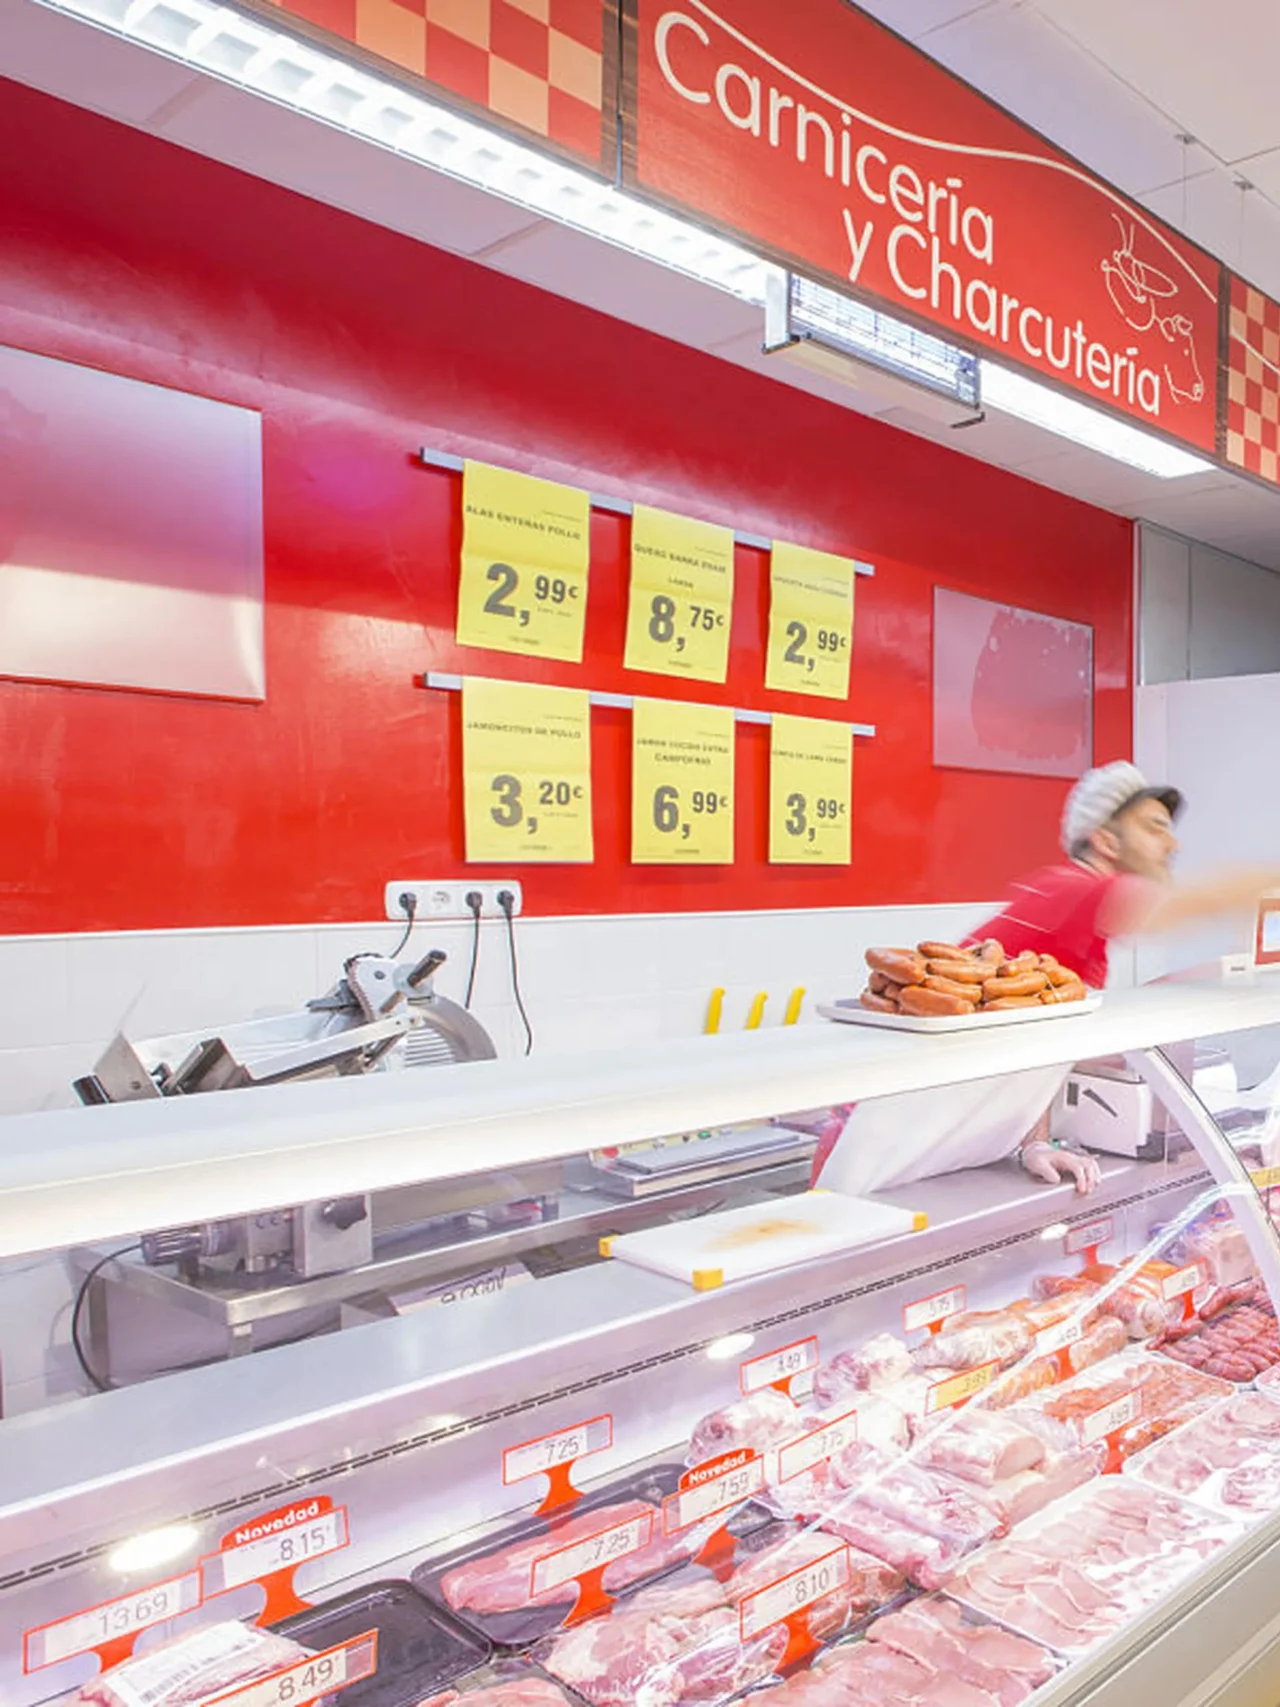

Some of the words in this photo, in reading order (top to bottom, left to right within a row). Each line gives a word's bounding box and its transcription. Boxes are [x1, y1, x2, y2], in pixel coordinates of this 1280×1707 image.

[653, 11, 994, 265] Carnicería
[842, 208, 874, 282] y
[886, 225, 1161, 416] Charcutería
[235, 1501, 319, 1544] Novedad
